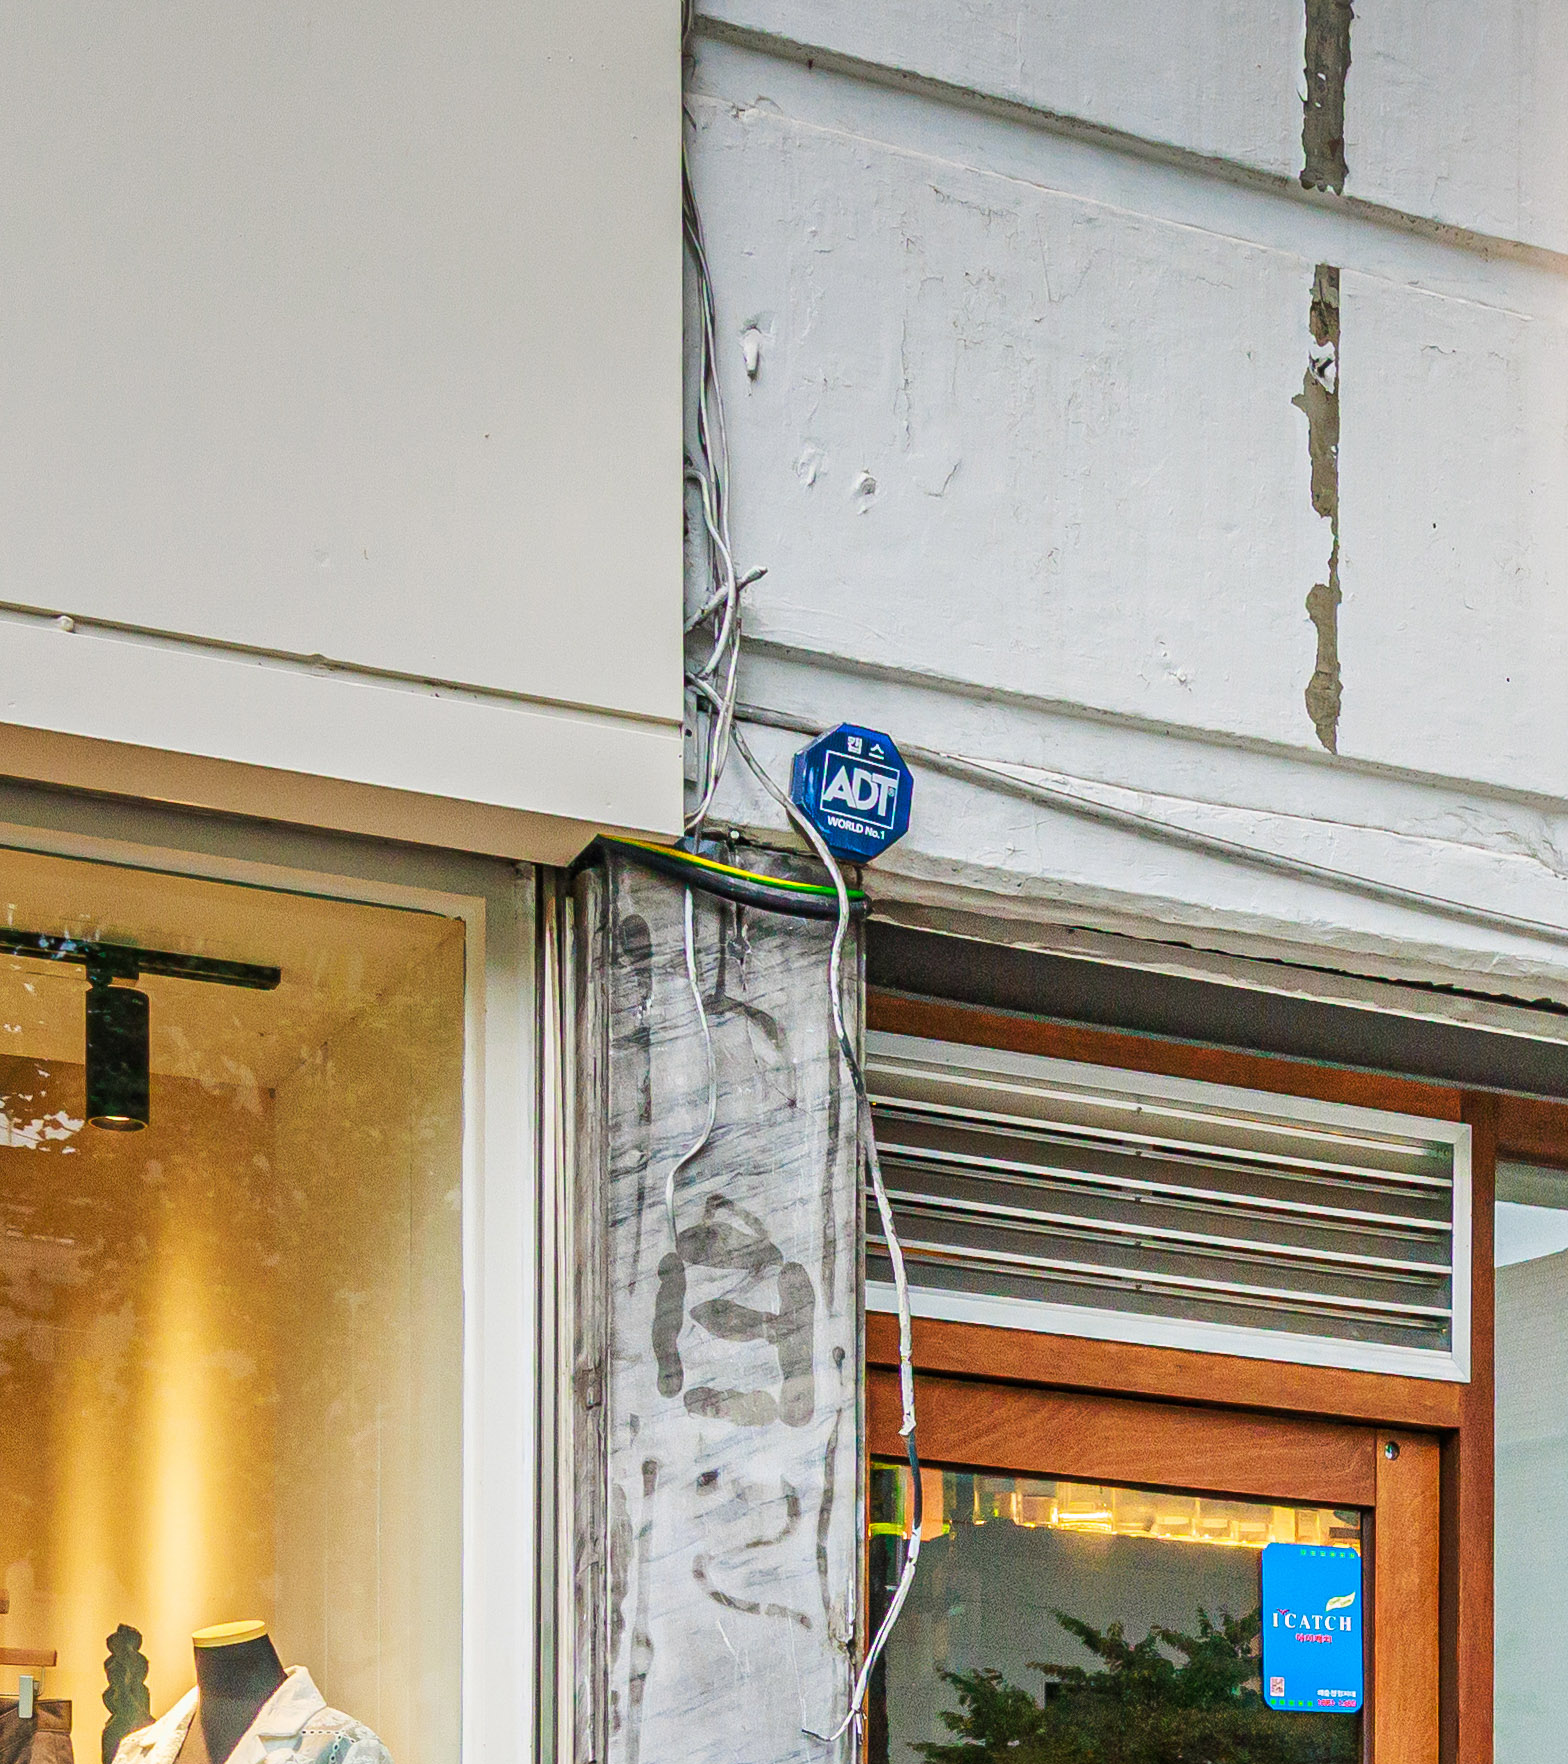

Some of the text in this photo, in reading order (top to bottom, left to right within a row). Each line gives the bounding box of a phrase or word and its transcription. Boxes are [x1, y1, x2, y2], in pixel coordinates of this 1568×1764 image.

[822, 765, 898, 816] ADT
[827, 816, 863, 833] WORLD
[1284, 1612, 1352, 1632] CATCH
